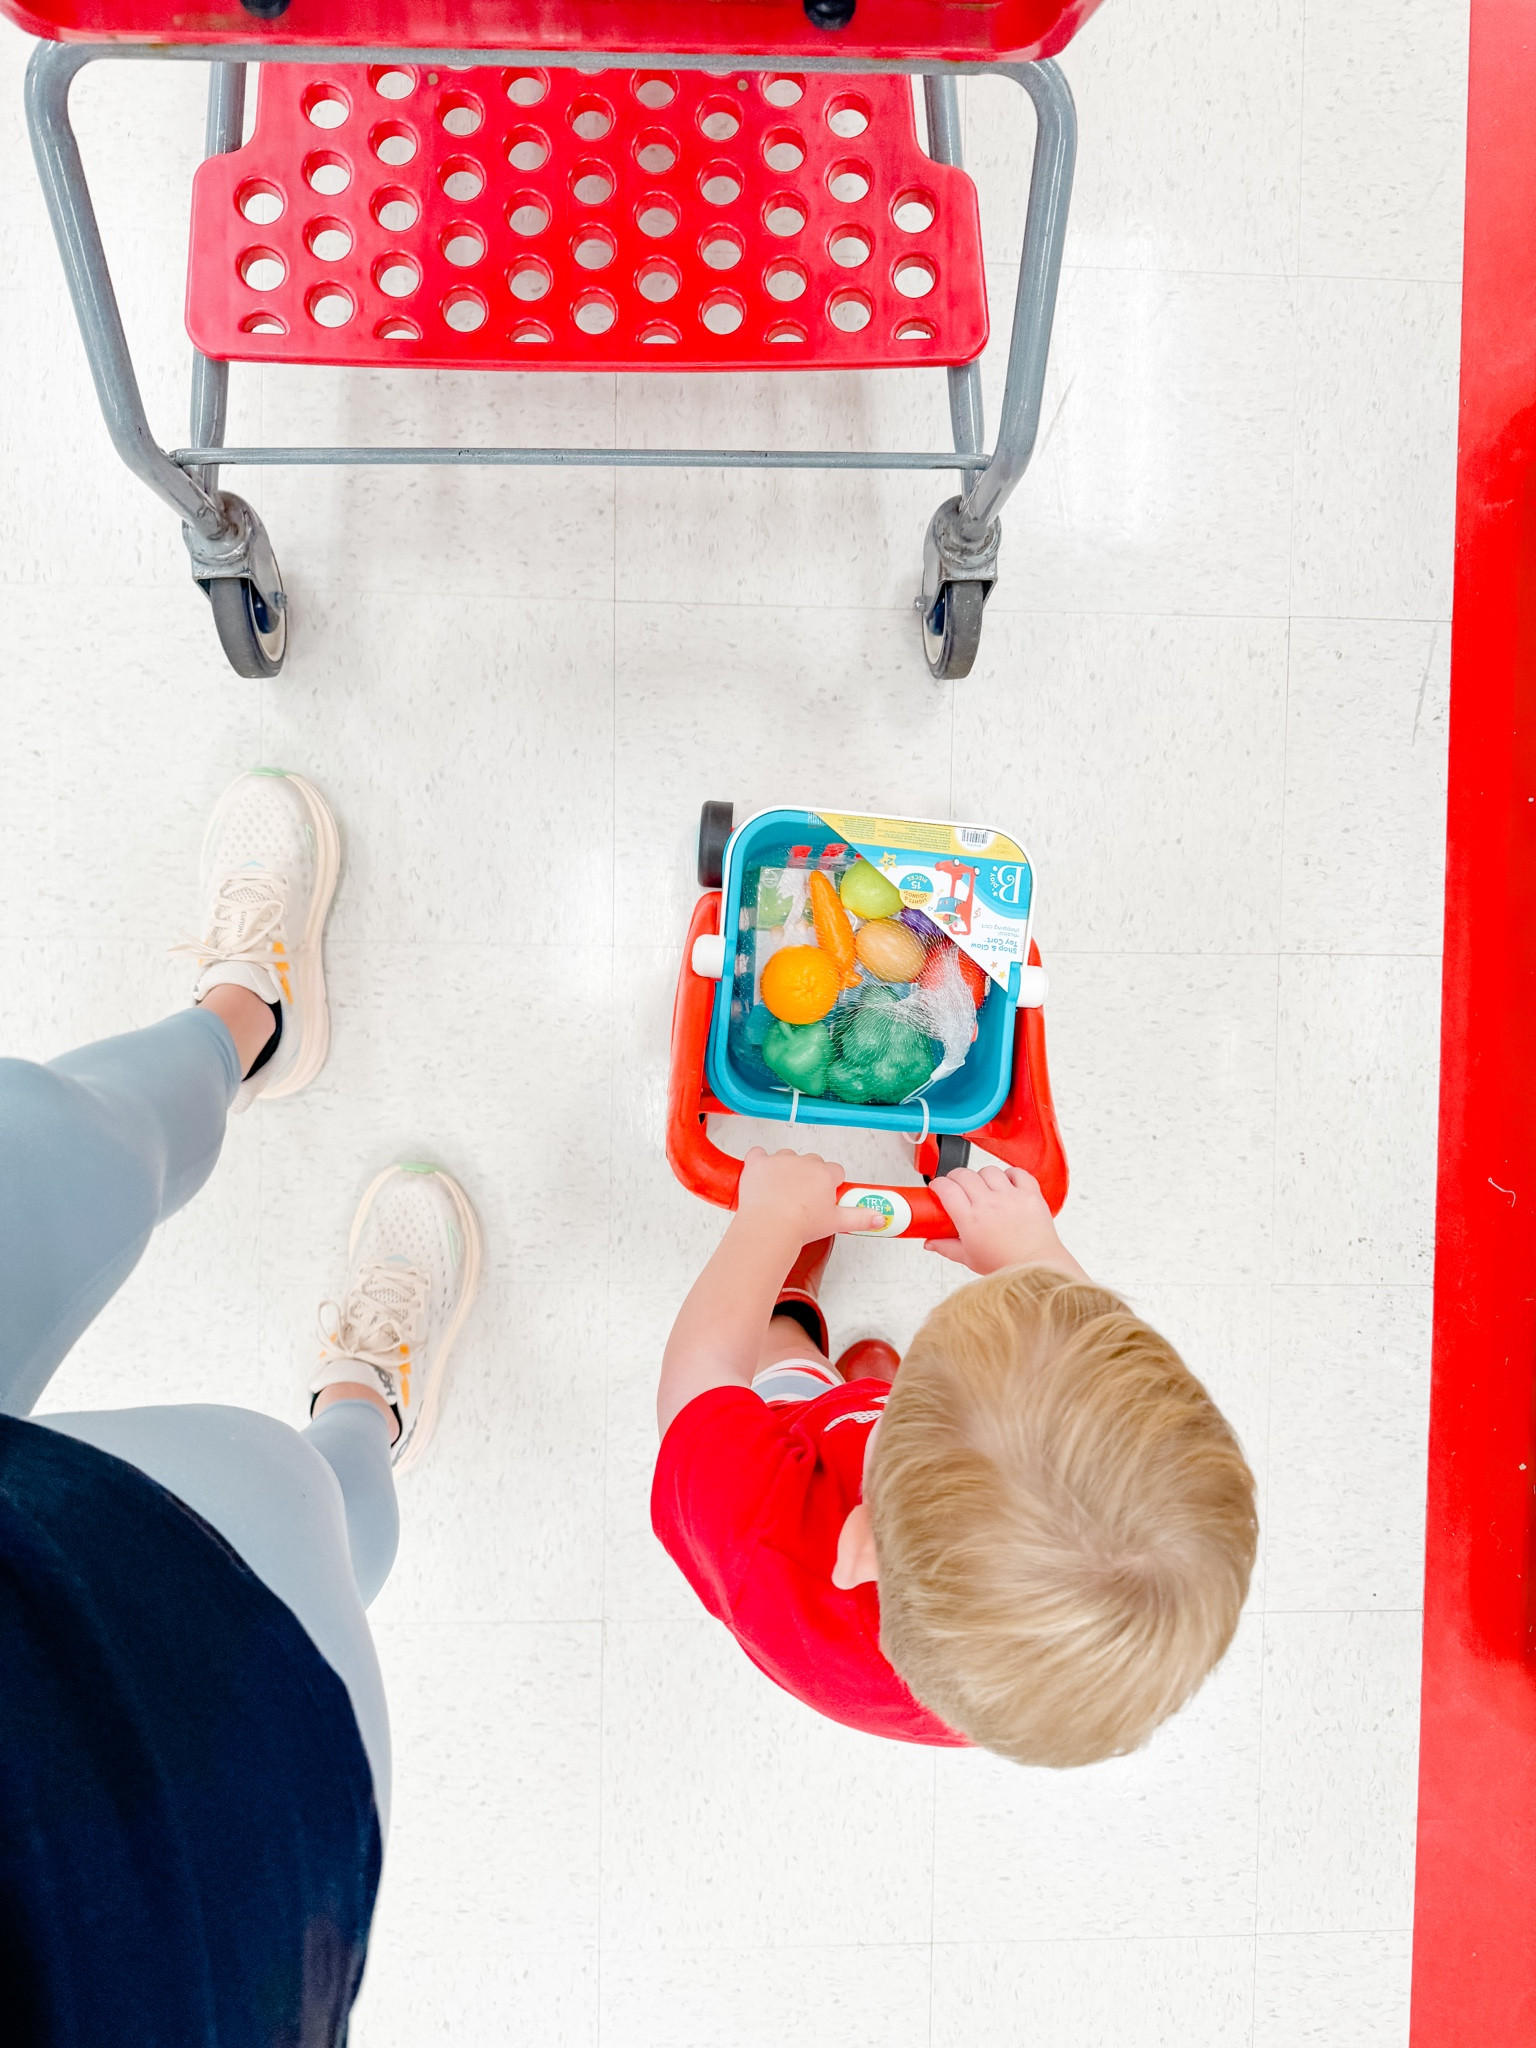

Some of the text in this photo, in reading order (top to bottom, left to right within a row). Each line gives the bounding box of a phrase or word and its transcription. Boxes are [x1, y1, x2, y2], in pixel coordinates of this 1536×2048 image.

[906, 875, 928, 884] PIECES
[911, 881, 922, 889] 15
[970, 943, 989, 951] Glow
[1004, 938, 1018, 948] Toy
[998, 945, 1018, 955] Shop
[865, 1197, 885, 1205] TRY
